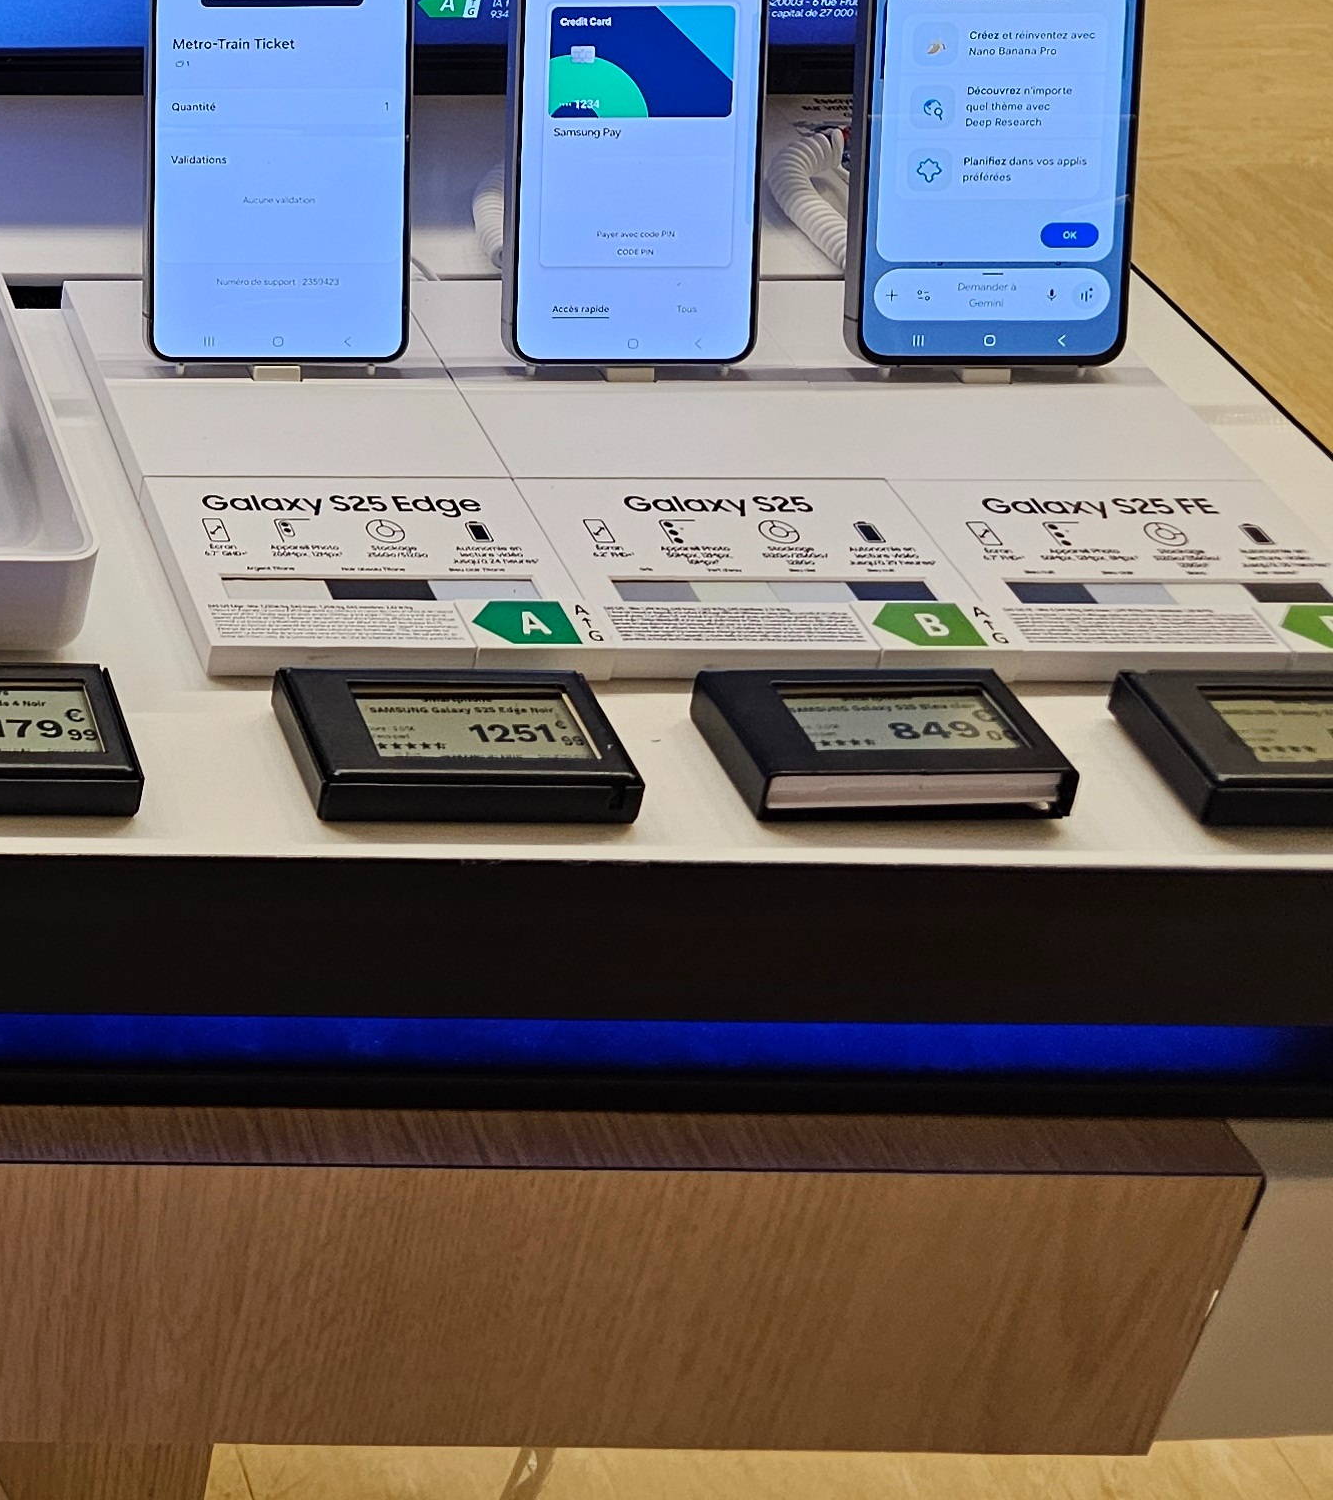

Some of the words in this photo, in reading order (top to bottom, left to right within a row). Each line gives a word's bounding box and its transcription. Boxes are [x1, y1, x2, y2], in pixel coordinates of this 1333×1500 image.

[560, 17, 587, 27] Credit
[590, 17, 612, 27] Card
[173, 38, 250, 50] Metro-Train
[254, 38, 295, 50] Ticket
[969, 47, 996, 56] Nano
[998, 47, 1037, 56] Banana
[1040, 47, 1057, 56] Pro
[967, 86, 1021, 96] Découvrez
[1024, 86, 1073, 97] n'importe
[172, 101, 216, 114] Quantité
[171, 154, 227, 165] Validations
[1063, 231, 1077, 240] OK
[552, 304, 579, 314] Accès
[582, 305, 609, 316] rapide
[677, 305, 697, 314] Tous
[202, 495, 323, 515] Galaxy
[329, 495, 388, 512] S25
[392, 496, 481, 516] Edge
[624, 496, 746, 515] Galaxy
[753, 496, 813, 513] S25
[982, 498, 1108, 517] Galaxy
[1111, 498, 1175, 513] S25
[1179, 499, 1219, 514] FE
[521, 612, 552, 635] A
[914, 613, 950, 636] B
[65, 707, 84, 722] €
[67, 729, 96, 741] 99
[468, 724, 557, 743] 1251
[888, 722, 980, 740] 849
